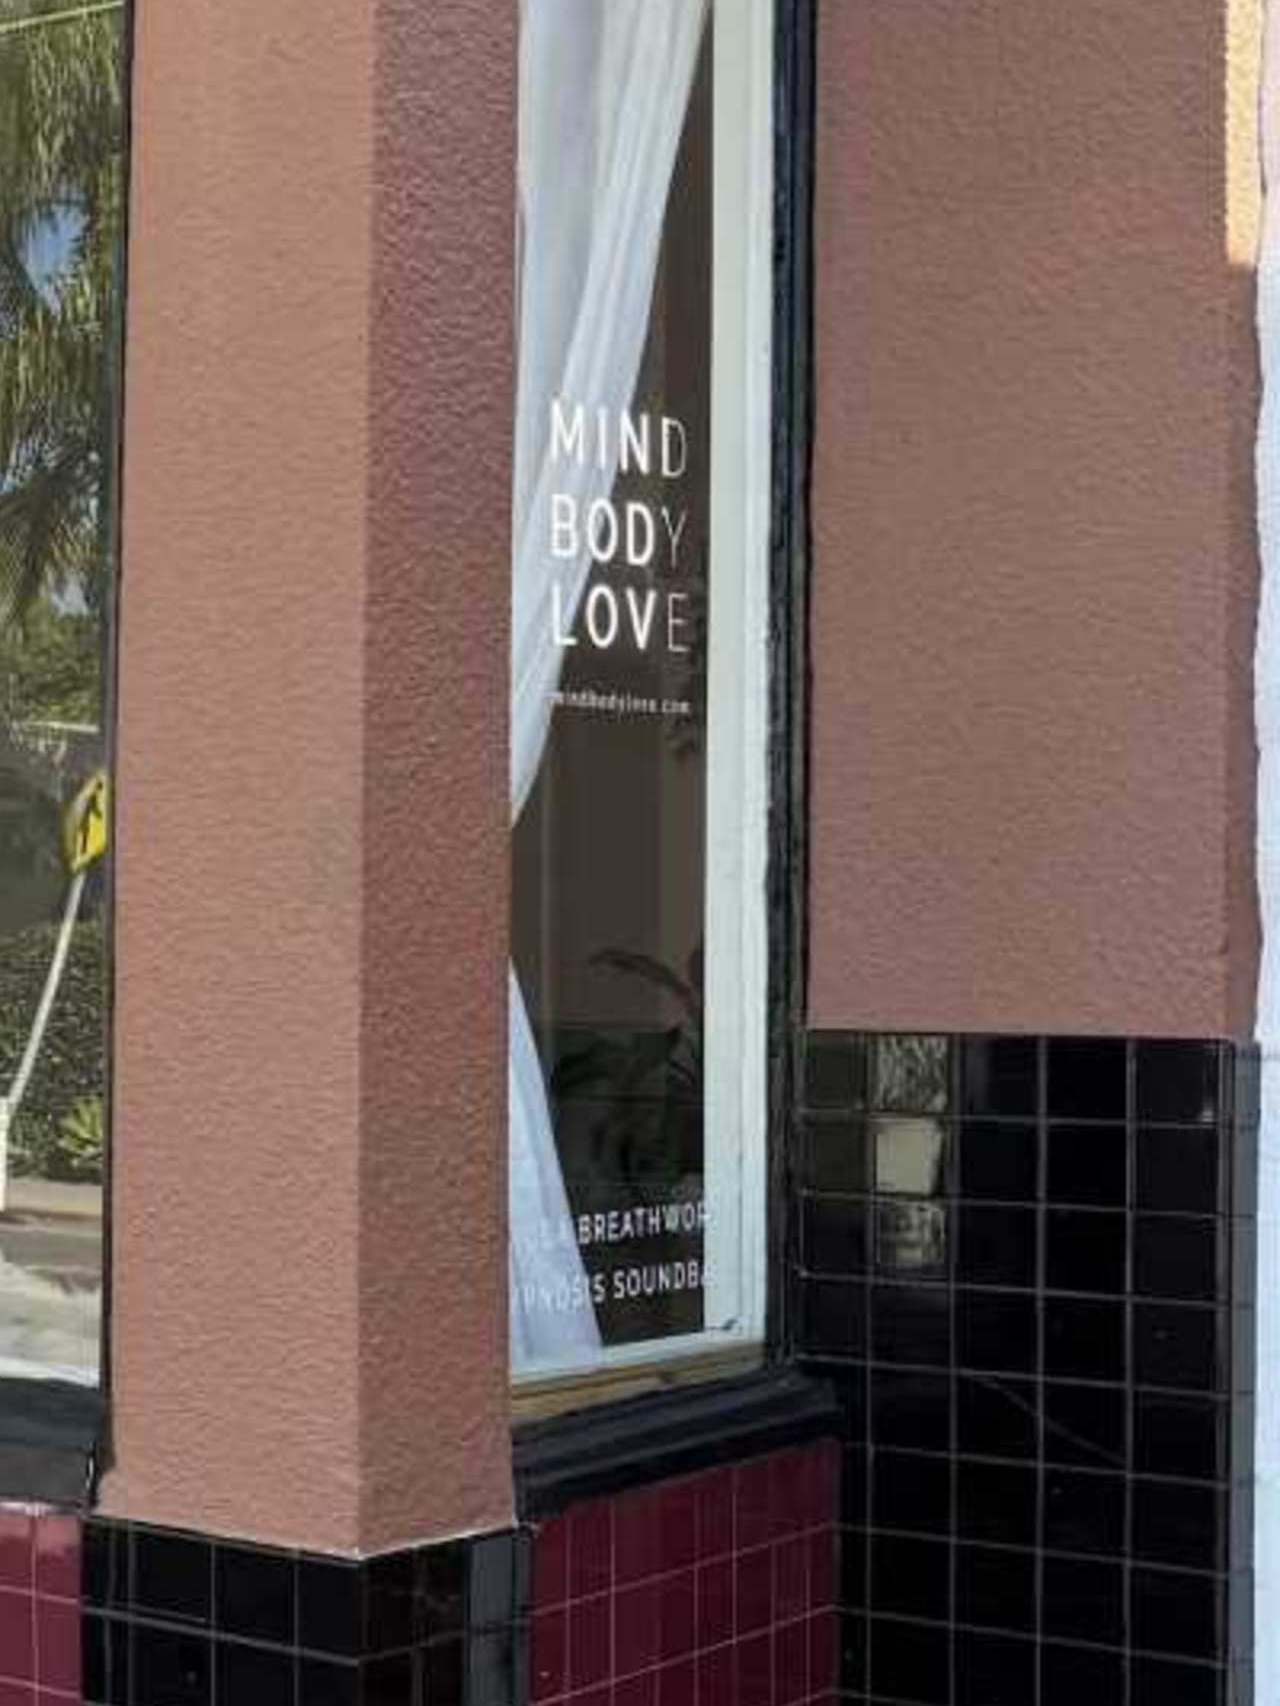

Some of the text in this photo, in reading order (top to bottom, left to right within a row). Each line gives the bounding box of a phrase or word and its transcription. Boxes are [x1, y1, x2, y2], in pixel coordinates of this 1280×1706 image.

[549, 397, 688, 480] MIND
[549, 494, 688, 570] BODY
[550, 582, 693, 654] LOVE
